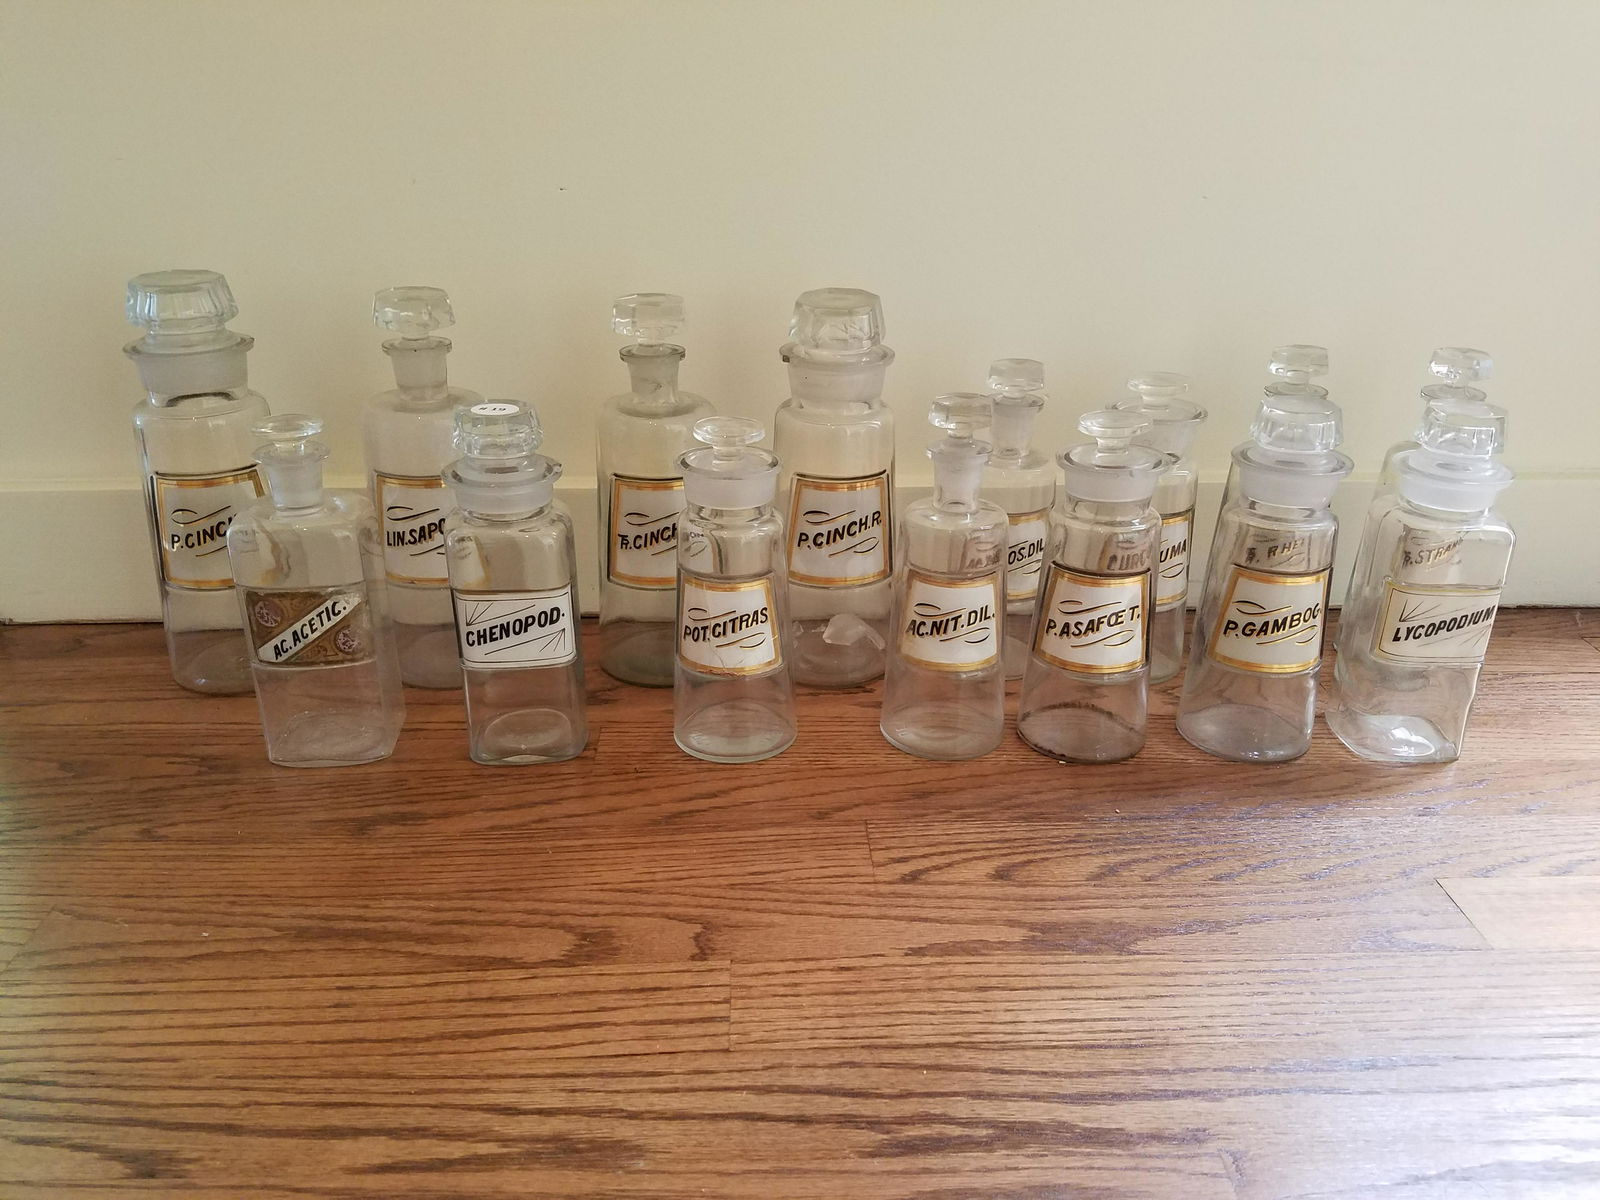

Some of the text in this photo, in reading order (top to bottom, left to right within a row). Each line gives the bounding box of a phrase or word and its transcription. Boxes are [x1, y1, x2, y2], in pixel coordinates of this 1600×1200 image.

[466, 606, 566, 647] CHENOPOD.
[683, 606, 769, 643] POT.CITRAS
[1392, 605, 1496, 642] LYCOPODIUM
